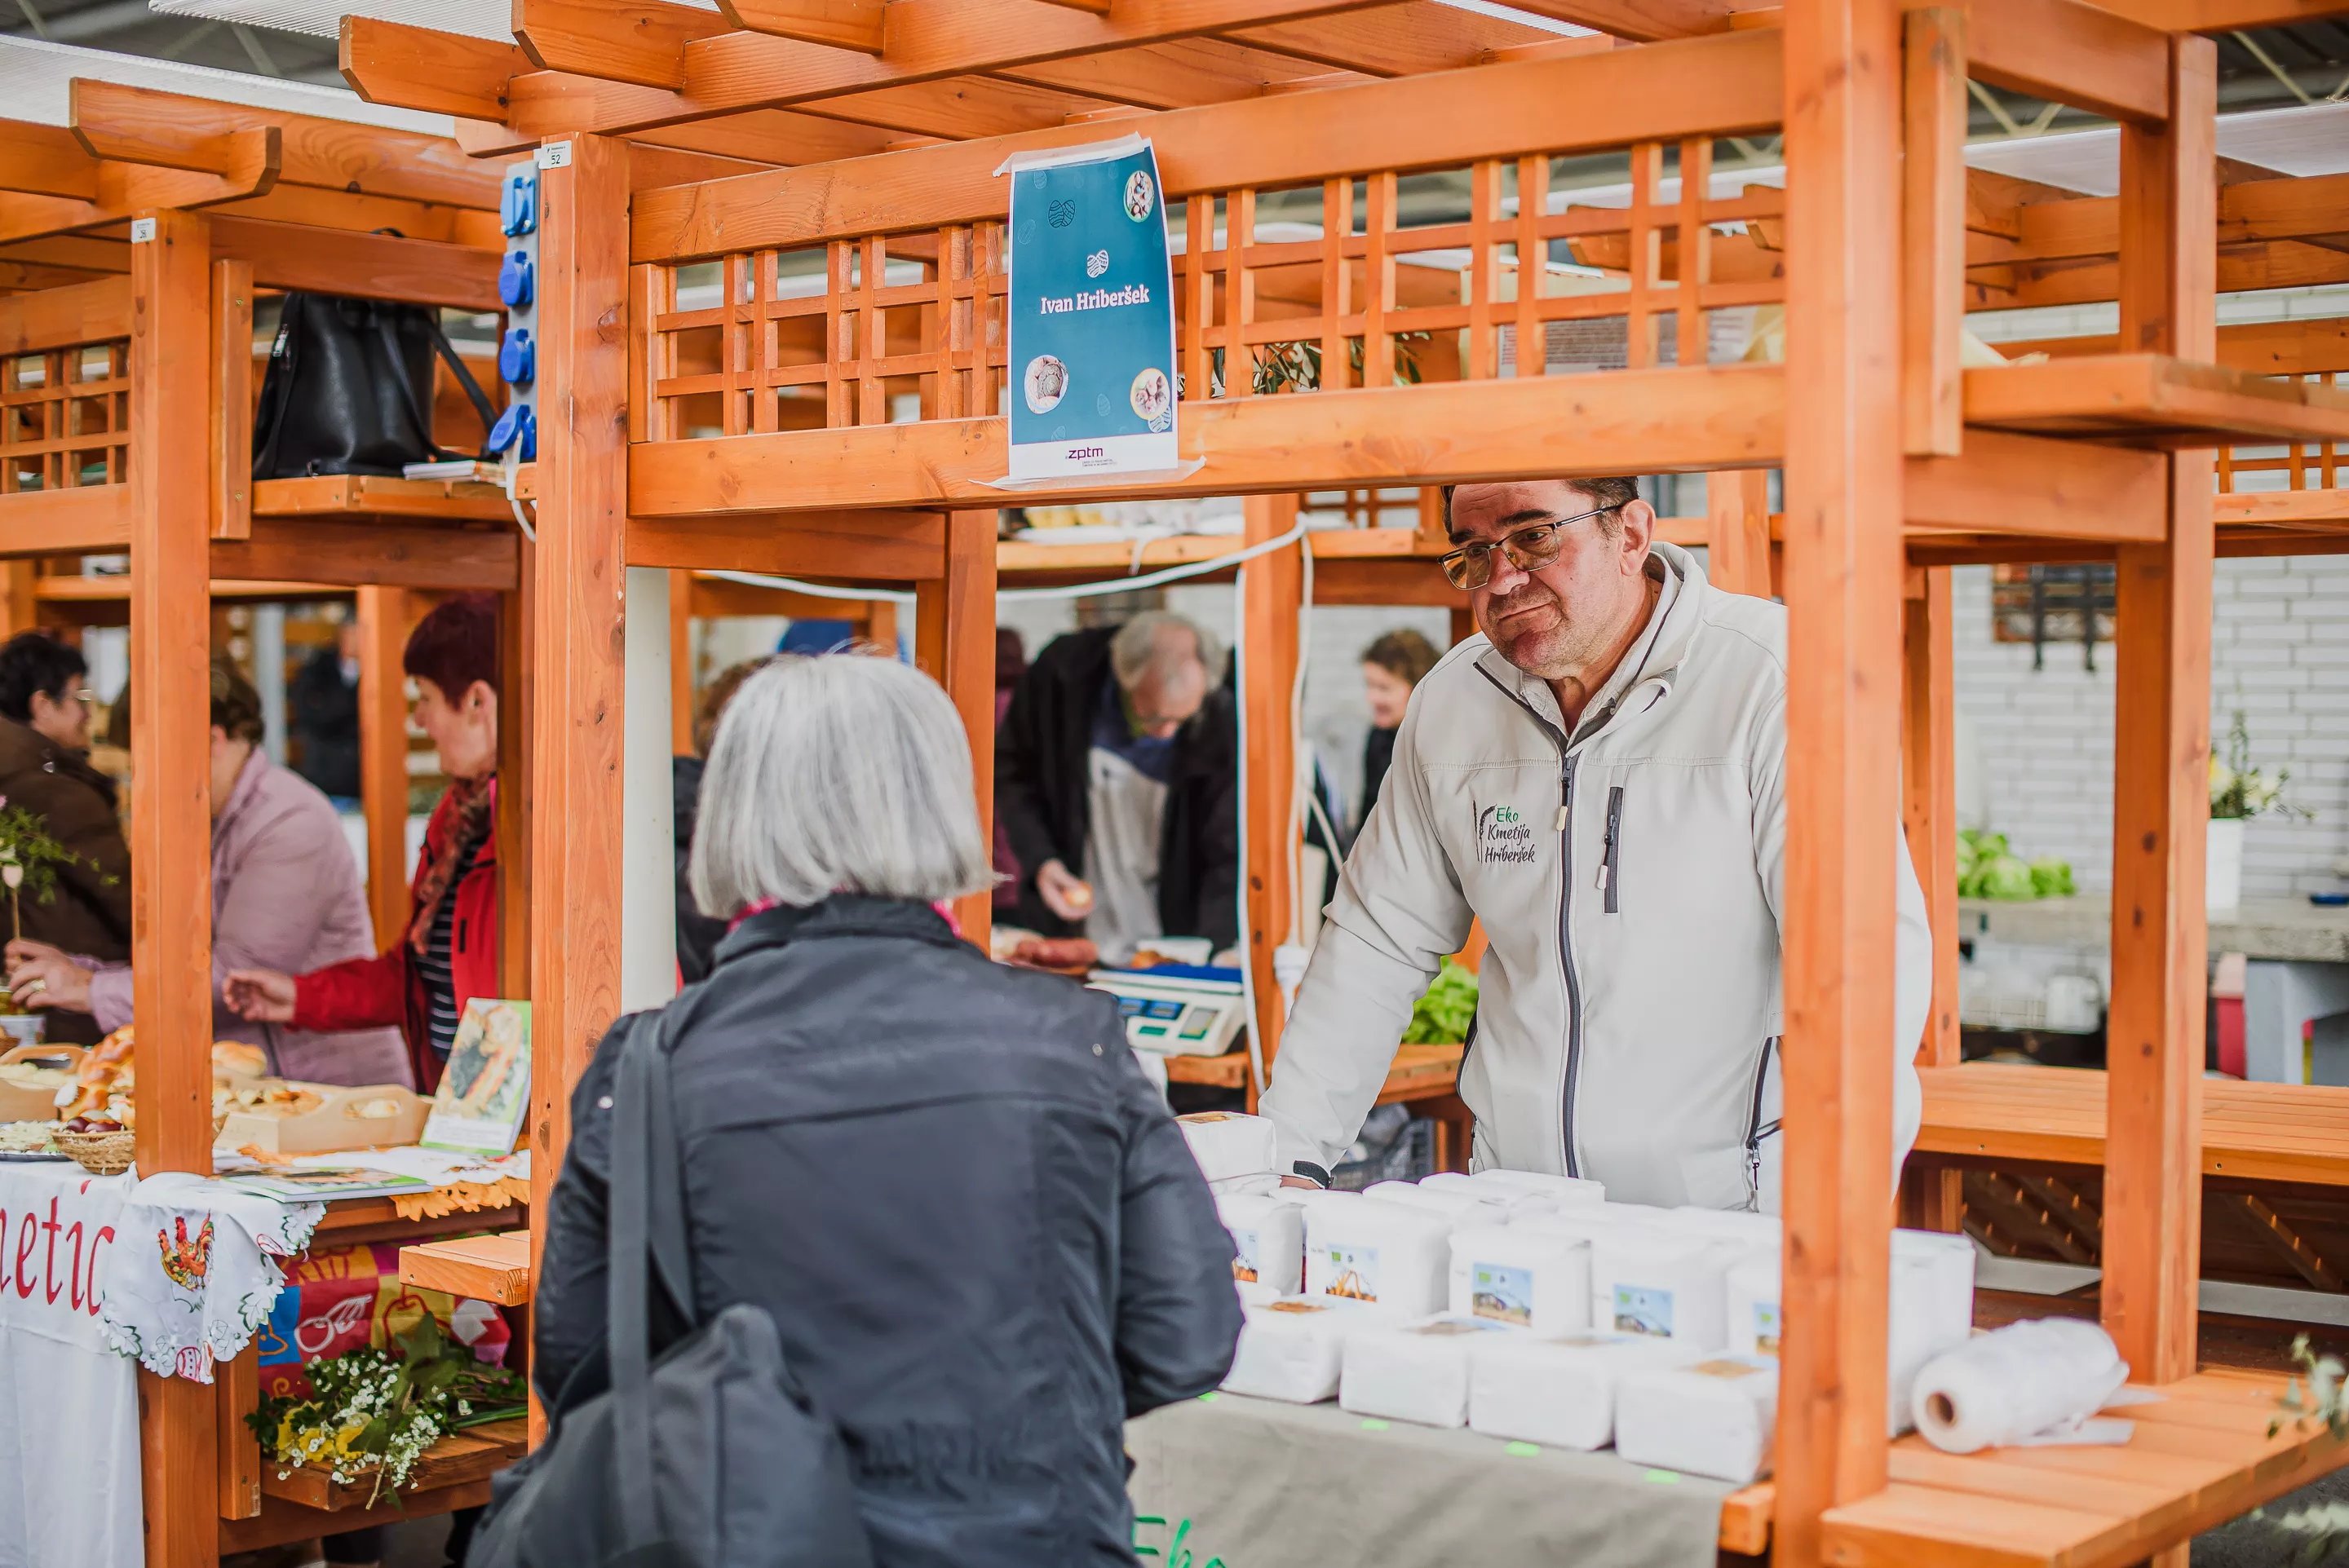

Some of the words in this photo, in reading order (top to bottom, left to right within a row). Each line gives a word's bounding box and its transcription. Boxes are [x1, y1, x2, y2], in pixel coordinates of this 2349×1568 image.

[551, 154, 561, 165] 52
[1040, 296, 1074, 315] Ivan
[1076, 283, 1150, 311] Hriberšek
[1068, 447, 1104, 460] zptm
[1496, 806, 1519, 823] Eko
[1487, 823, 1531, 846] Kmetija
[1484, 843, 1535, 863] Hriberšek
